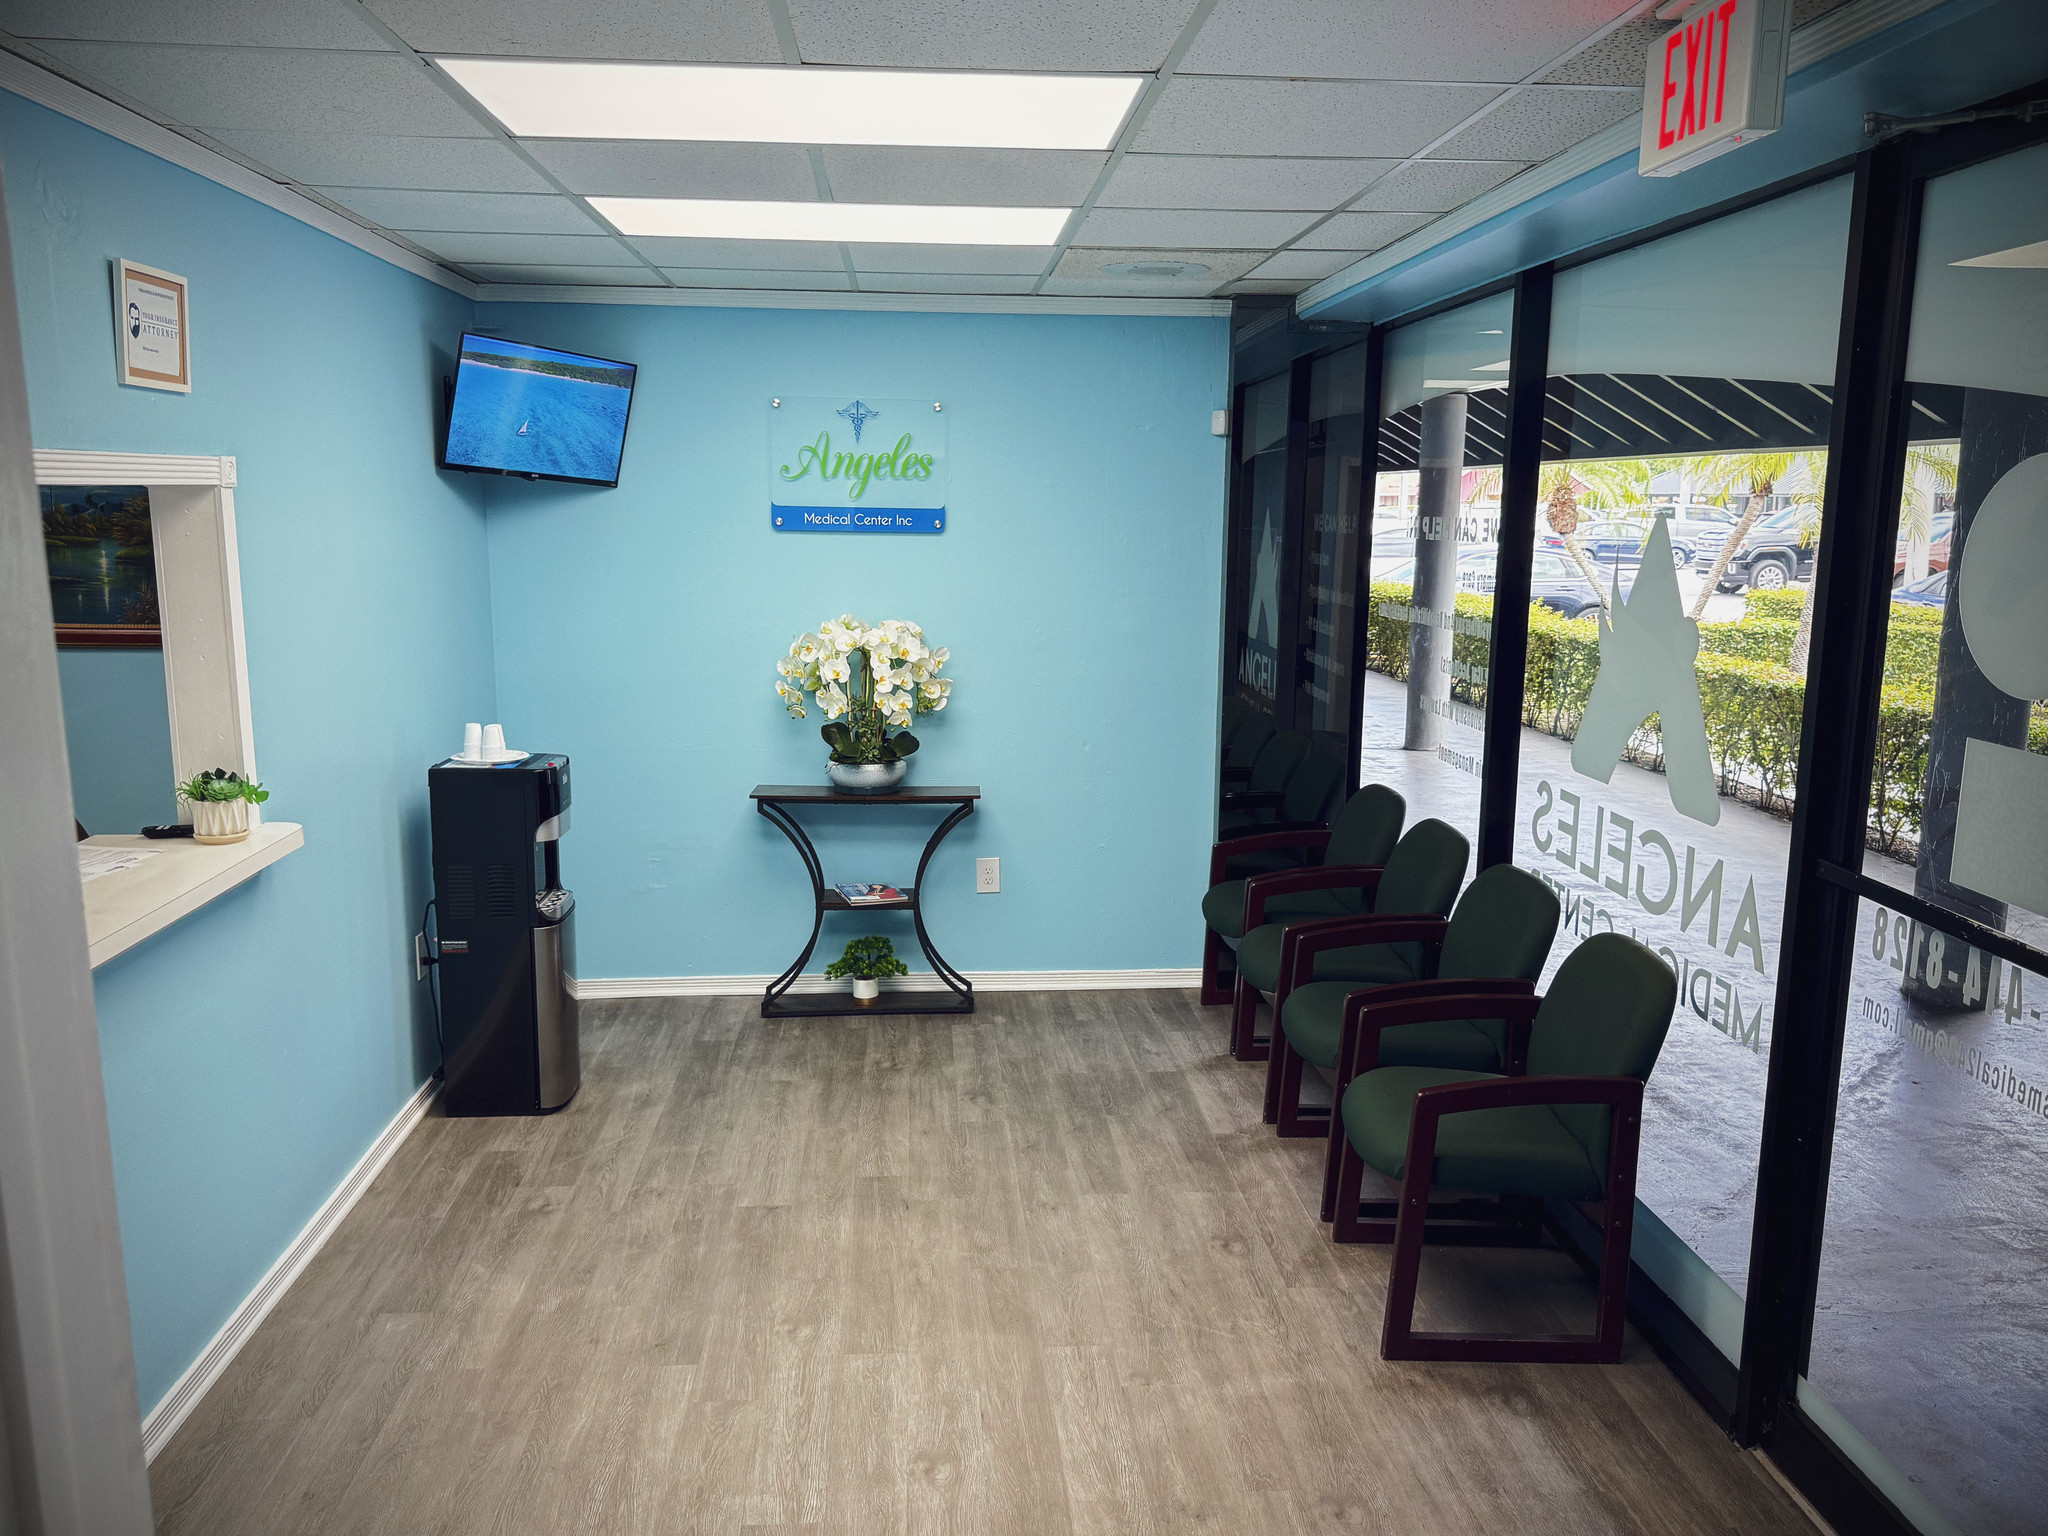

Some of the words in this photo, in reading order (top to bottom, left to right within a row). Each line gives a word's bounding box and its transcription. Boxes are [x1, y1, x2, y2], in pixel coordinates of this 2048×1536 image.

[1658, 0, 1737, 151] EXIT
[142, 324, 179, 340] ATTORNEY
[779, 430, 934, 499] Angeles
[804, 512, 851, 526] Medical
[854, 513, 891, 526] Center
[896, 515, 912, 526] Inc
[1238, 644, 1277, 702] ANGEL
